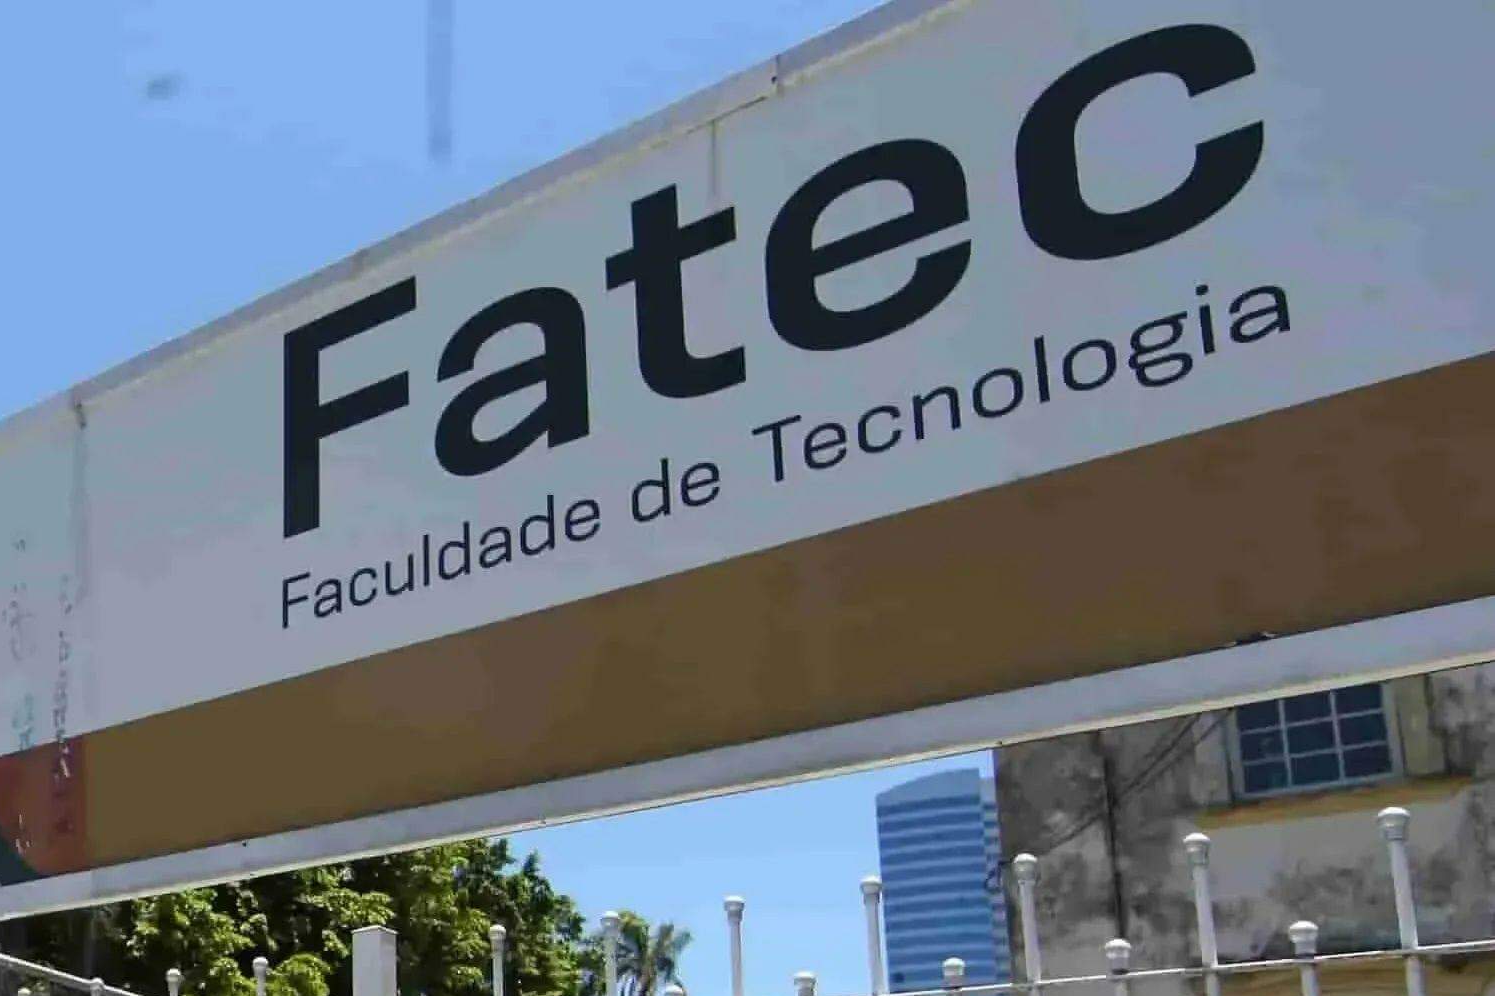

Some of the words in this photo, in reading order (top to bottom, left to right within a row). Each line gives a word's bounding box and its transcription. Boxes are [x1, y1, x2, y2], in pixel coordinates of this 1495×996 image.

[282, 494, 601, 629] Faculdade
[631, 457, 721, 523] de
[751, 284, 1291, 483] Tecnologia
[283, 23, 1264, 538] Fatec
